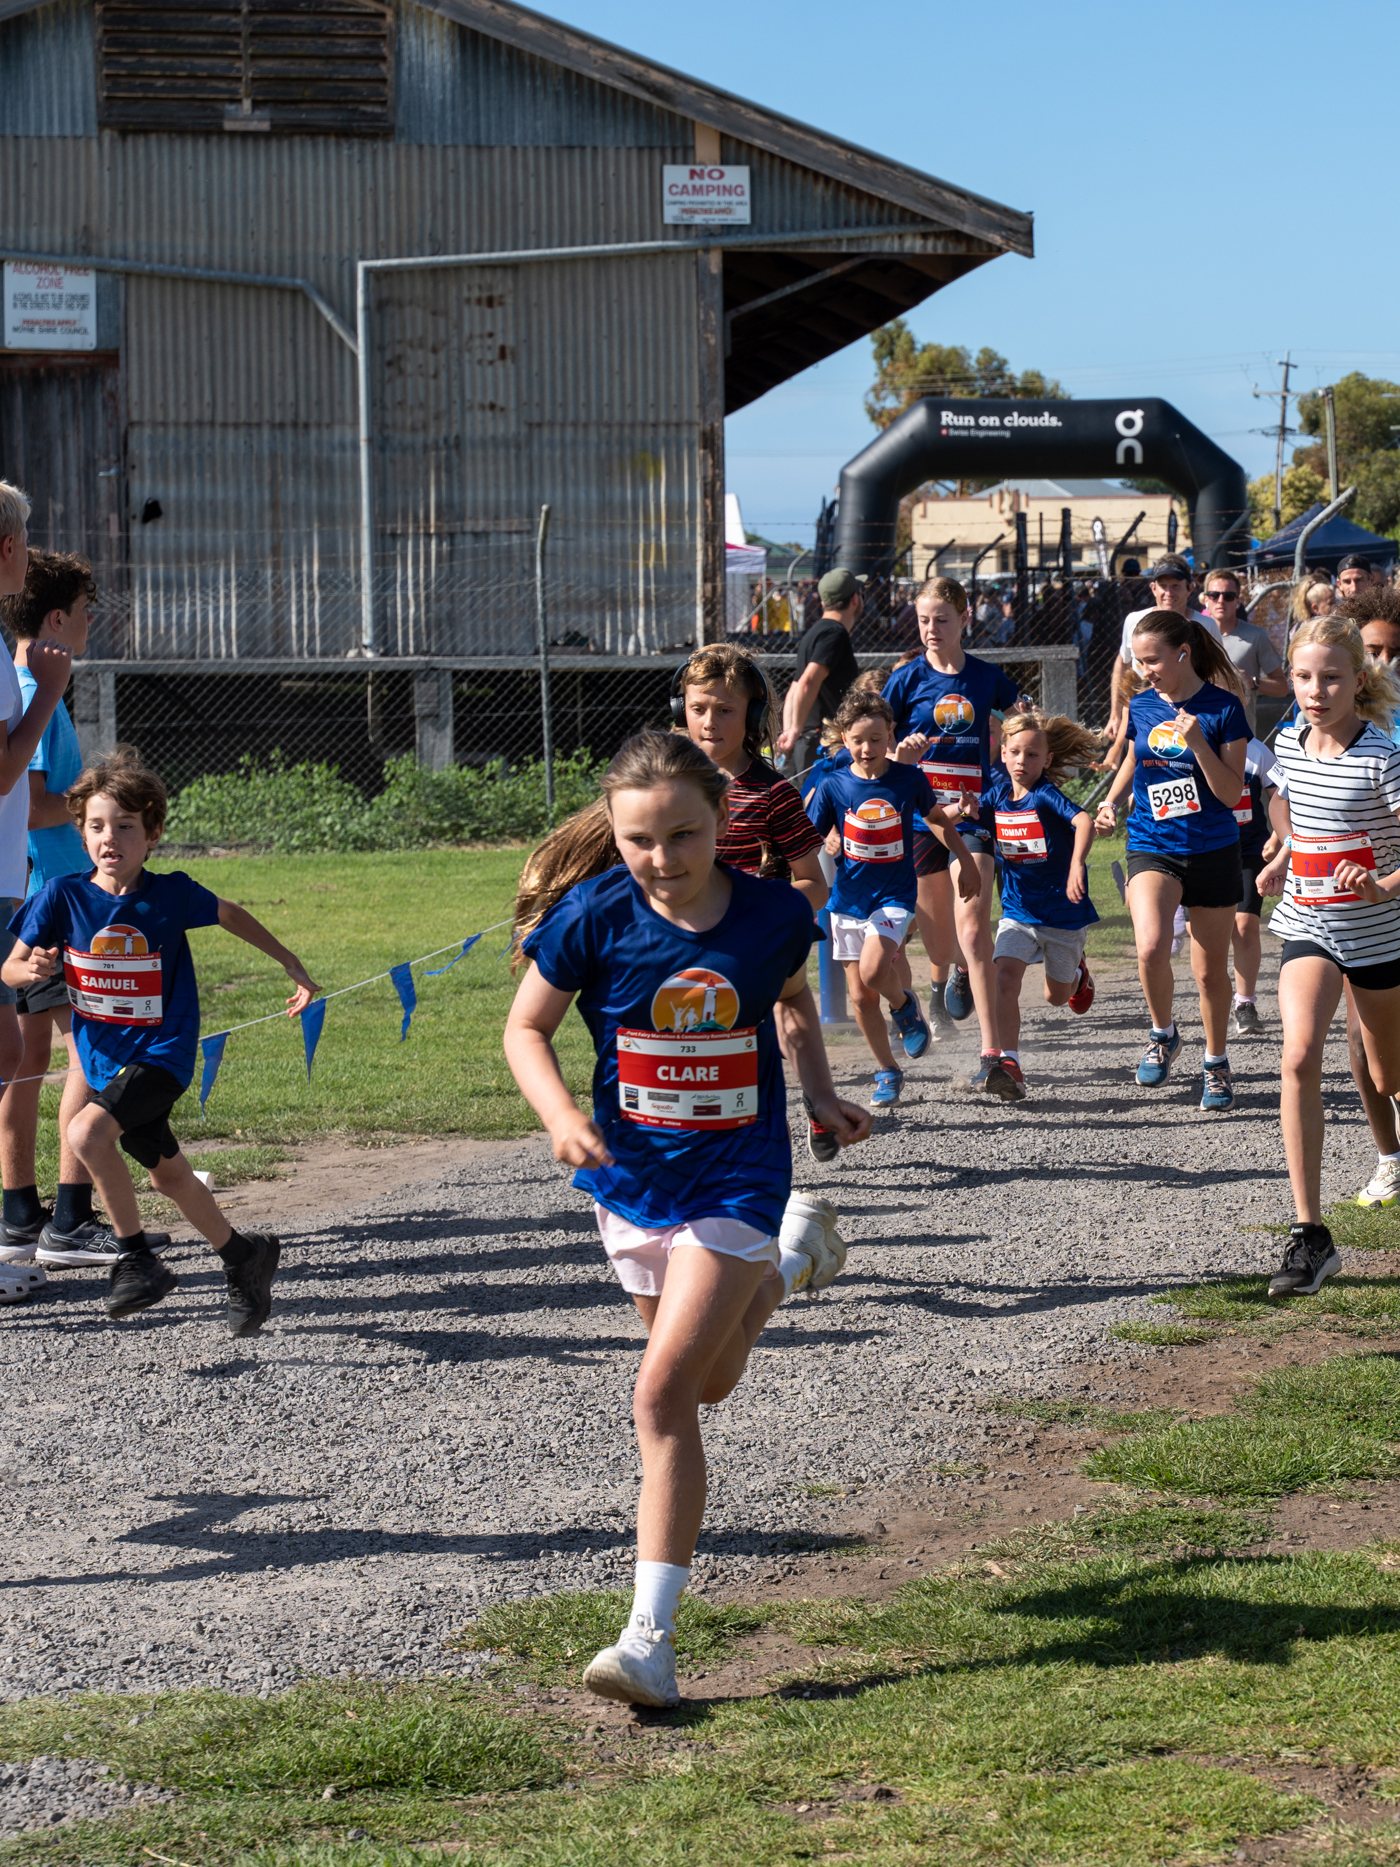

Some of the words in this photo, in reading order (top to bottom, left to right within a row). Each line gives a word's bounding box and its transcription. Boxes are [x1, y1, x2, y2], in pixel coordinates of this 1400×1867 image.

[689, 168, 726, 181] NO
[668, 184, 746, 197] CAMPING
[12, 262, 60, 276] ALCOHOL
[64, 265, 90, 277] FREE
[36, 276, 64, 290] ZONE
[940, 411, 975, 426] Run
[978, 414, 1000, 426] on
[1003, 411, 1062, 426] clouds.
[948, 428, 969, 436] Swiss
[970, 428, 1011, 438] Engineering
[932, 776, 953, 790] Paige
[1152, 784, 1195, 808] 5298
[1000, 828, 1028, 836] TOMMY
[81, 975, 139, 990] SAMUEL
[657, 1066, 719, 1081] CLARE
